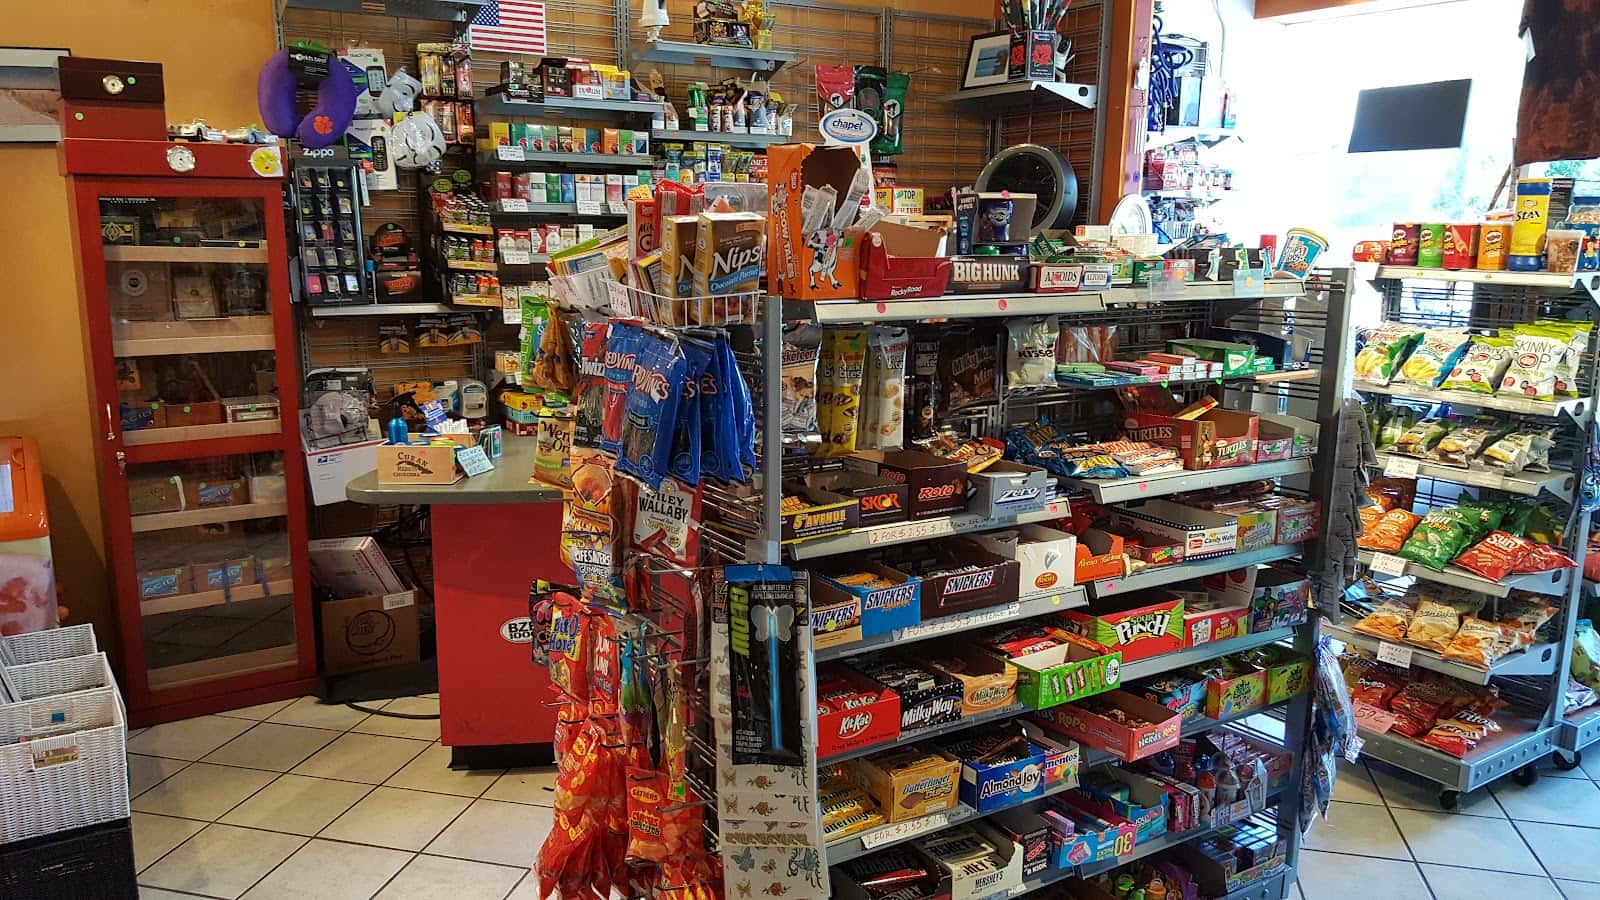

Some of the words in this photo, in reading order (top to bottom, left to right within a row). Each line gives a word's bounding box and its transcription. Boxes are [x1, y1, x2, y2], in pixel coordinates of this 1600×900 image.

[303, 148, 334, 159] Zippo
[877, 191, 887, 201] TOP
[904, 190, 915, 200] TOP
[779, 208, 790, 240] COW
[711, 247, 761, 281] Nips
[952, 262, 982, 282] BIG
[982, 264, 1020, 281] HUNK
[1018, 349, 1054, 359] KISSE
[1128, 426, 1172, 441] TURTLES
[861, 494, 902, 511] SKOR
[919, 486, 955, 500] Rolo
[639, 496, 689, 524] WALLABY
[1486, 533, 1519, 551] Sun
[945, 570, 993, 595] SNICKERS
[864, 585, 915, 610] SNICKERS
[730, 587, 750, 657] GLOW
[1114, 613, 1171, 645] PUNCH
[1131, 615, 1155, 625] SOUR
[902, 705, 931, 728] Milky
[930, 697, 955, 715] Way
[1044, 753, 1079, 769] mentos
[903, 775, 952, 794] Butterfinger
[980, 772, 1022, 799] Almond
[1020, 771, 1041, 786] Joy
[824, 810, 877, 834] utterfing
[963, 856, 999, 876] HEY'S
[974, 871, 1004, 889] HERSHEY'S
